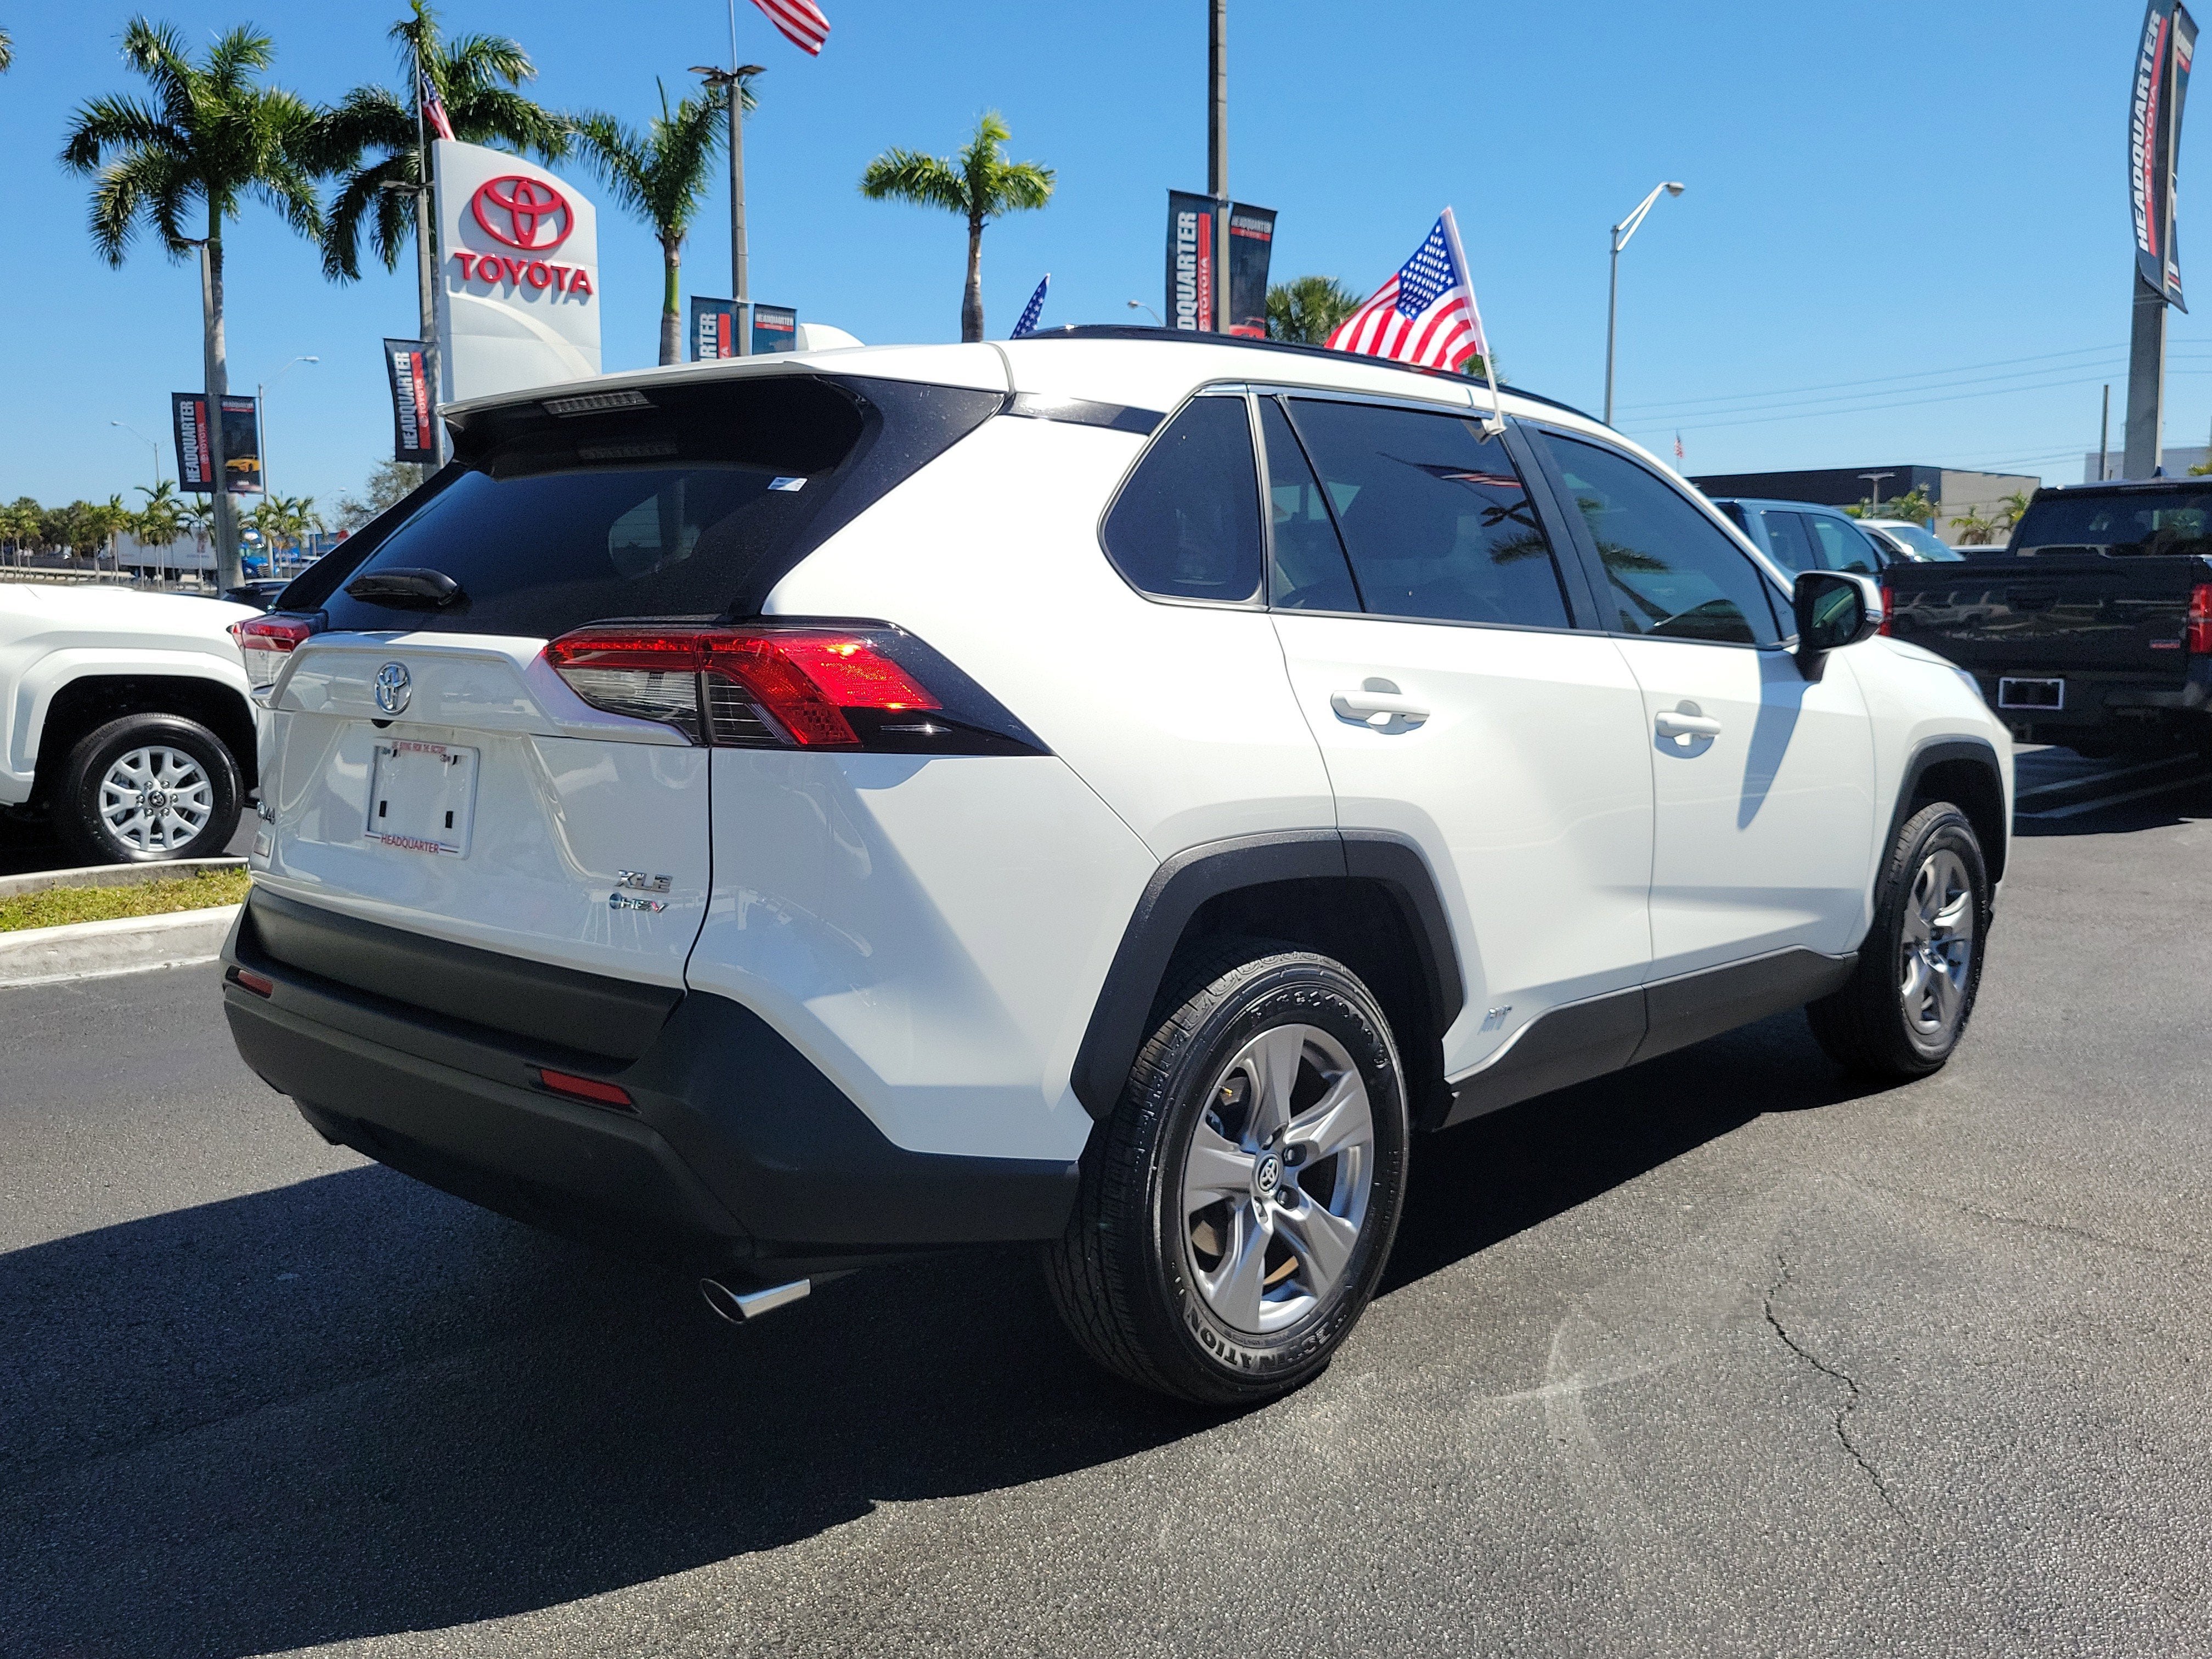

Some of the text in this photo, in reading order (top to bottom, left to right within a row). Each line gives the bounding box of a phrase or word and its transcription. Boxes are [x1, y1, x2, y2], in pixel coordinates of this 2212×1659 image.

[2132, 10, 2161, 252] HEADQUARTER
[2145, 84, 2158, 172] TOYOTA
[454, 252, 594, 295] TOYOTA
[1176, 212, 1198, 330] DQUARTER
[394, 352, 419, 450] HEADQUARTER
[415, 379, 427, 414] TOYOTA
[180, 400, 201, 483] HEADQUARTER
[381, 834, 439, 854] HEADQUARTER
[614, 869, 673, 893] XLE
